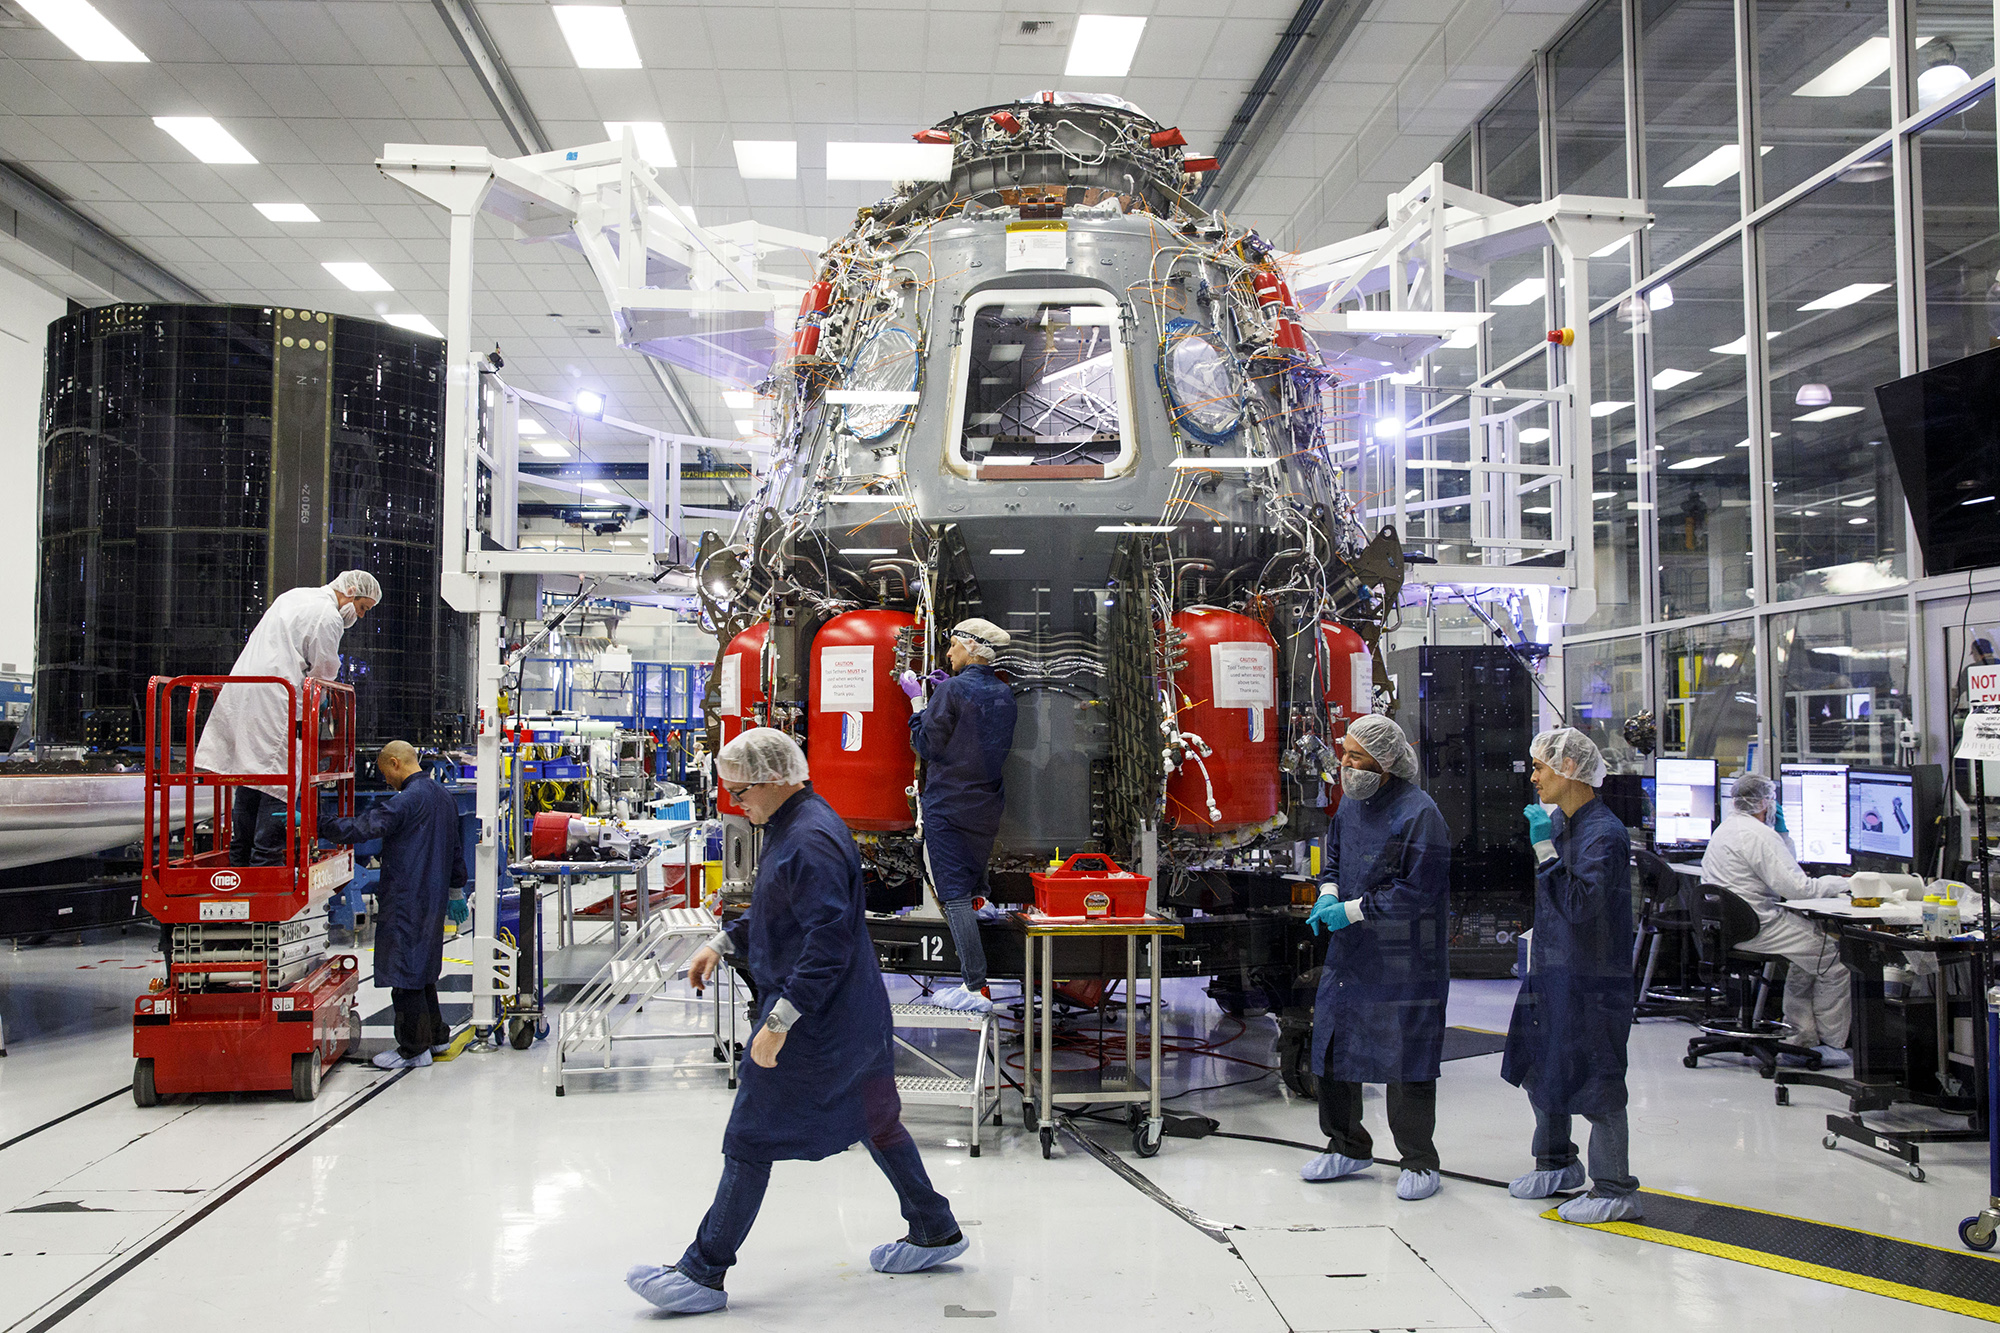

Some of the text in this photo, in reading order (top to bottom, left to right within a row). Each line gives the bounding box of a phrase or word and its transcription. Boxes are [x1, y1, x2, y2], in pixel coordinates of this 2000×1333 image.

[680, 471, 706, 479] APACITY
[301, 503, 310, 524] DEG
[1971, 674, 1997, 689] NOT
[131, 895, 139, 916] 7
[920, 935, 943, 962] 12
